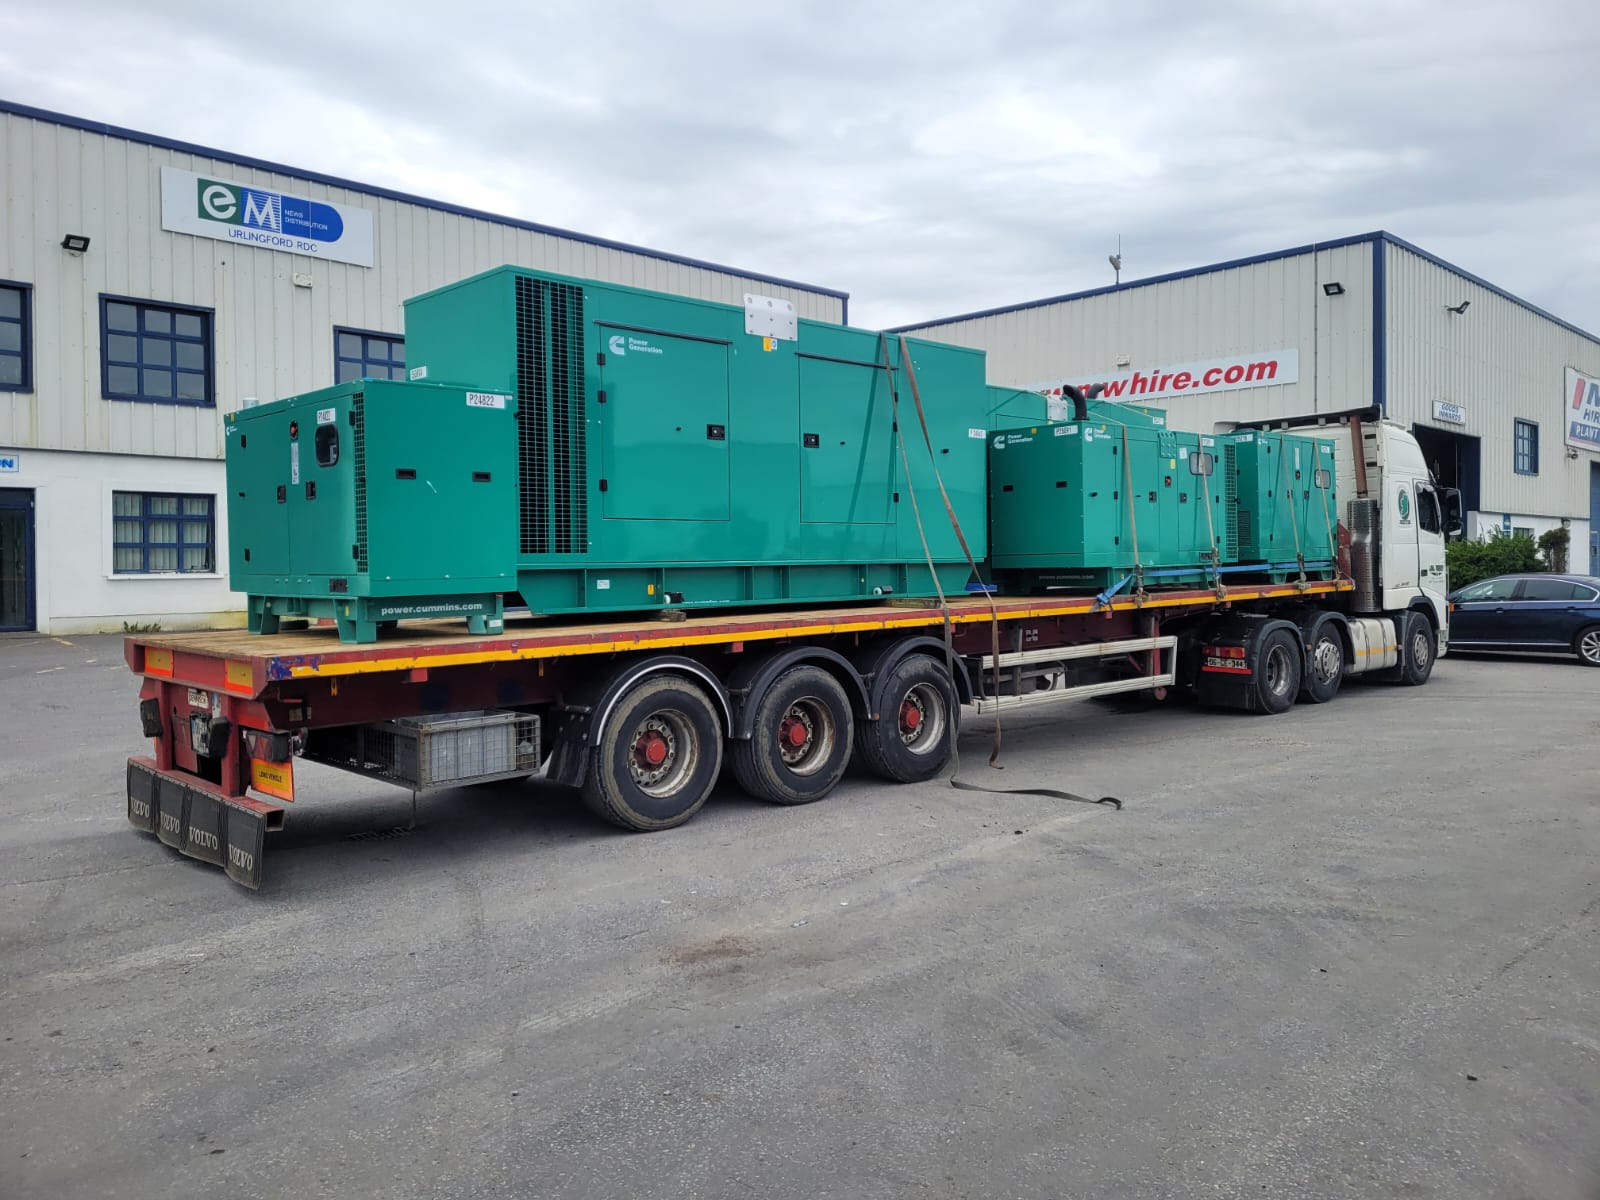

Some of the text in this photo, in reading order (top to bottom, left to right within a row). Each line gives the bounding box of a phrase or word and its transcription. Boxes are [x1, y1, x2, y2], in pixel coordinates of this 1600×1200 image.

[285, 210, 303, 218] NEWS
[285, 217, 328, 230] DISTRIBUTION
[228, 229, 318, 252] URLINGFORD RDC
[629, 337, 648, 346] Power
[629, 344, 663, 354] Generation
[1441, 403, 1459, 413] GOODS
[1576, 425, 1599, 439] PLANT
[381, 603, 483, 616] power.cummins.com
[130, 796, 150, 818] VOLVO
[160, 811, 180, 834] VOLVO
[189, 826, 218, 850] VOLVO
[228, 844, 253, 871] VOLVO
